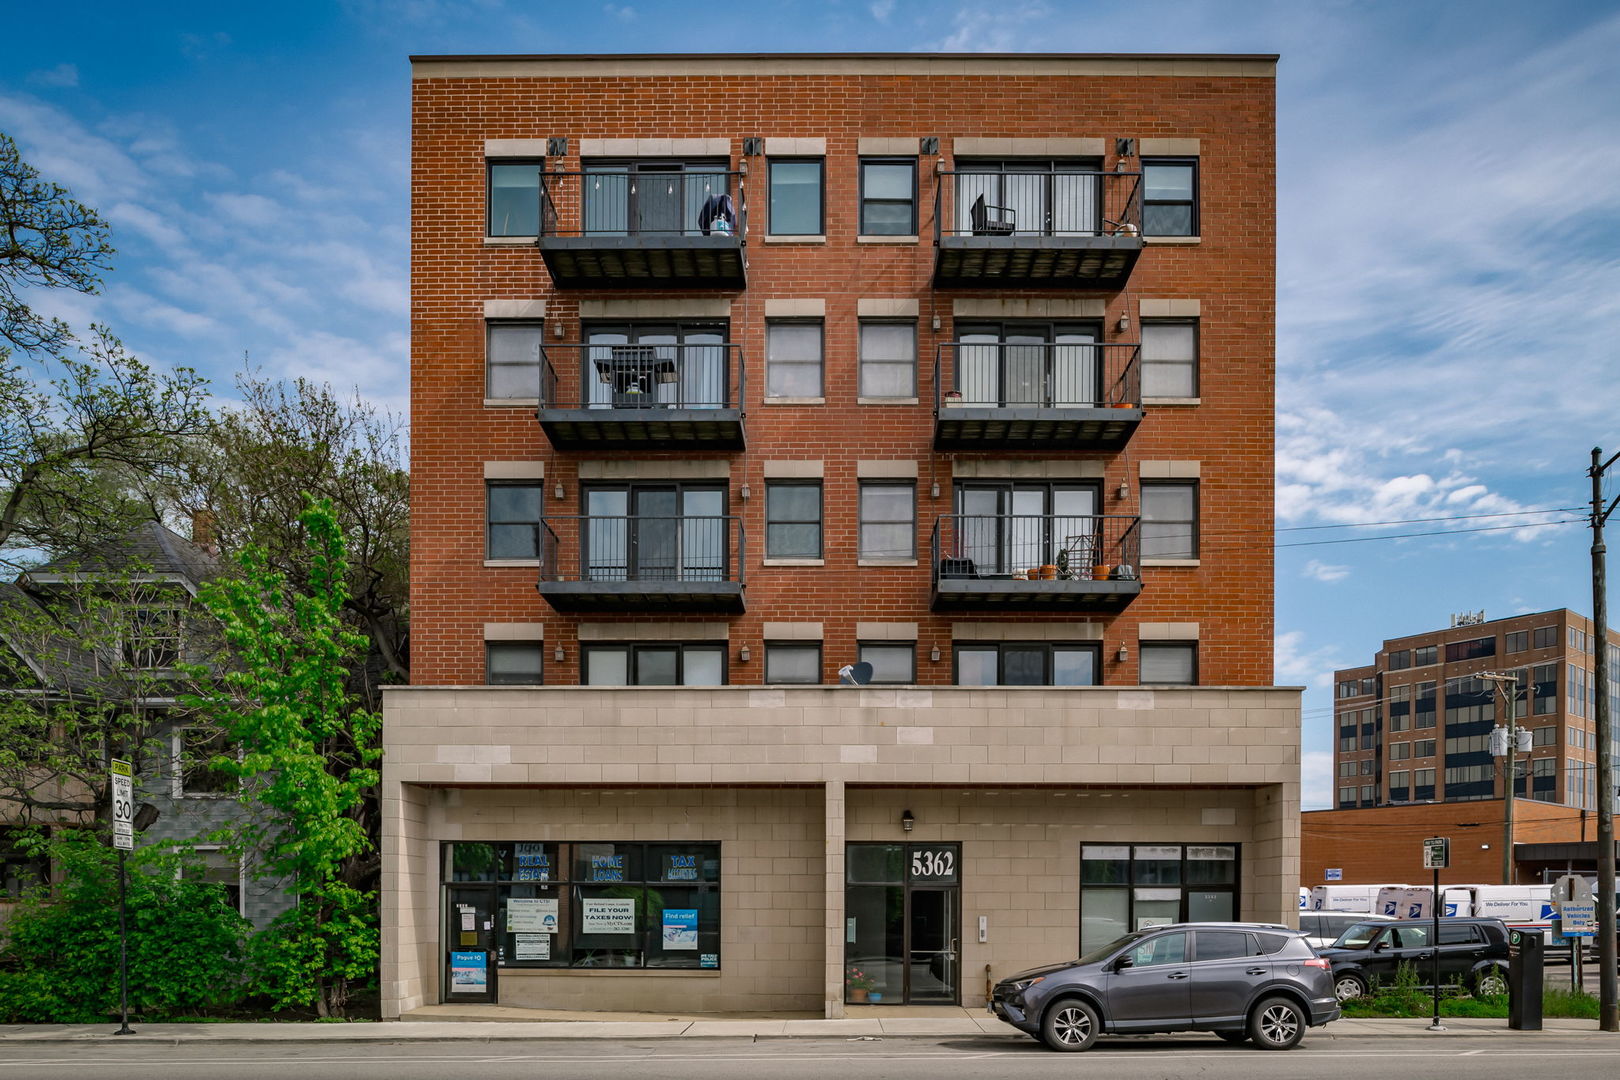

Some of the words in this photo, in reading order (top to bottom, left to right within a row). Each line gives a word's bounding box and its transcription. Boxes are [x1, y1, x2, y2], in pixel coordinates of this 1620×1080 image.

[115, 777, 130, 787] SPEED
[116, 788, 129, 798] LIMIT
[115, 799, 131, 819] 30
[519, 855, 549, 866] REAL
[592, 855, 624, 868] HOME
[671, 855, 696, 867] TAX
[912, 851, 954, 876] 5362
[593, 869, 623, 882] LOANS
[1512, 933, 1518, 942] P
